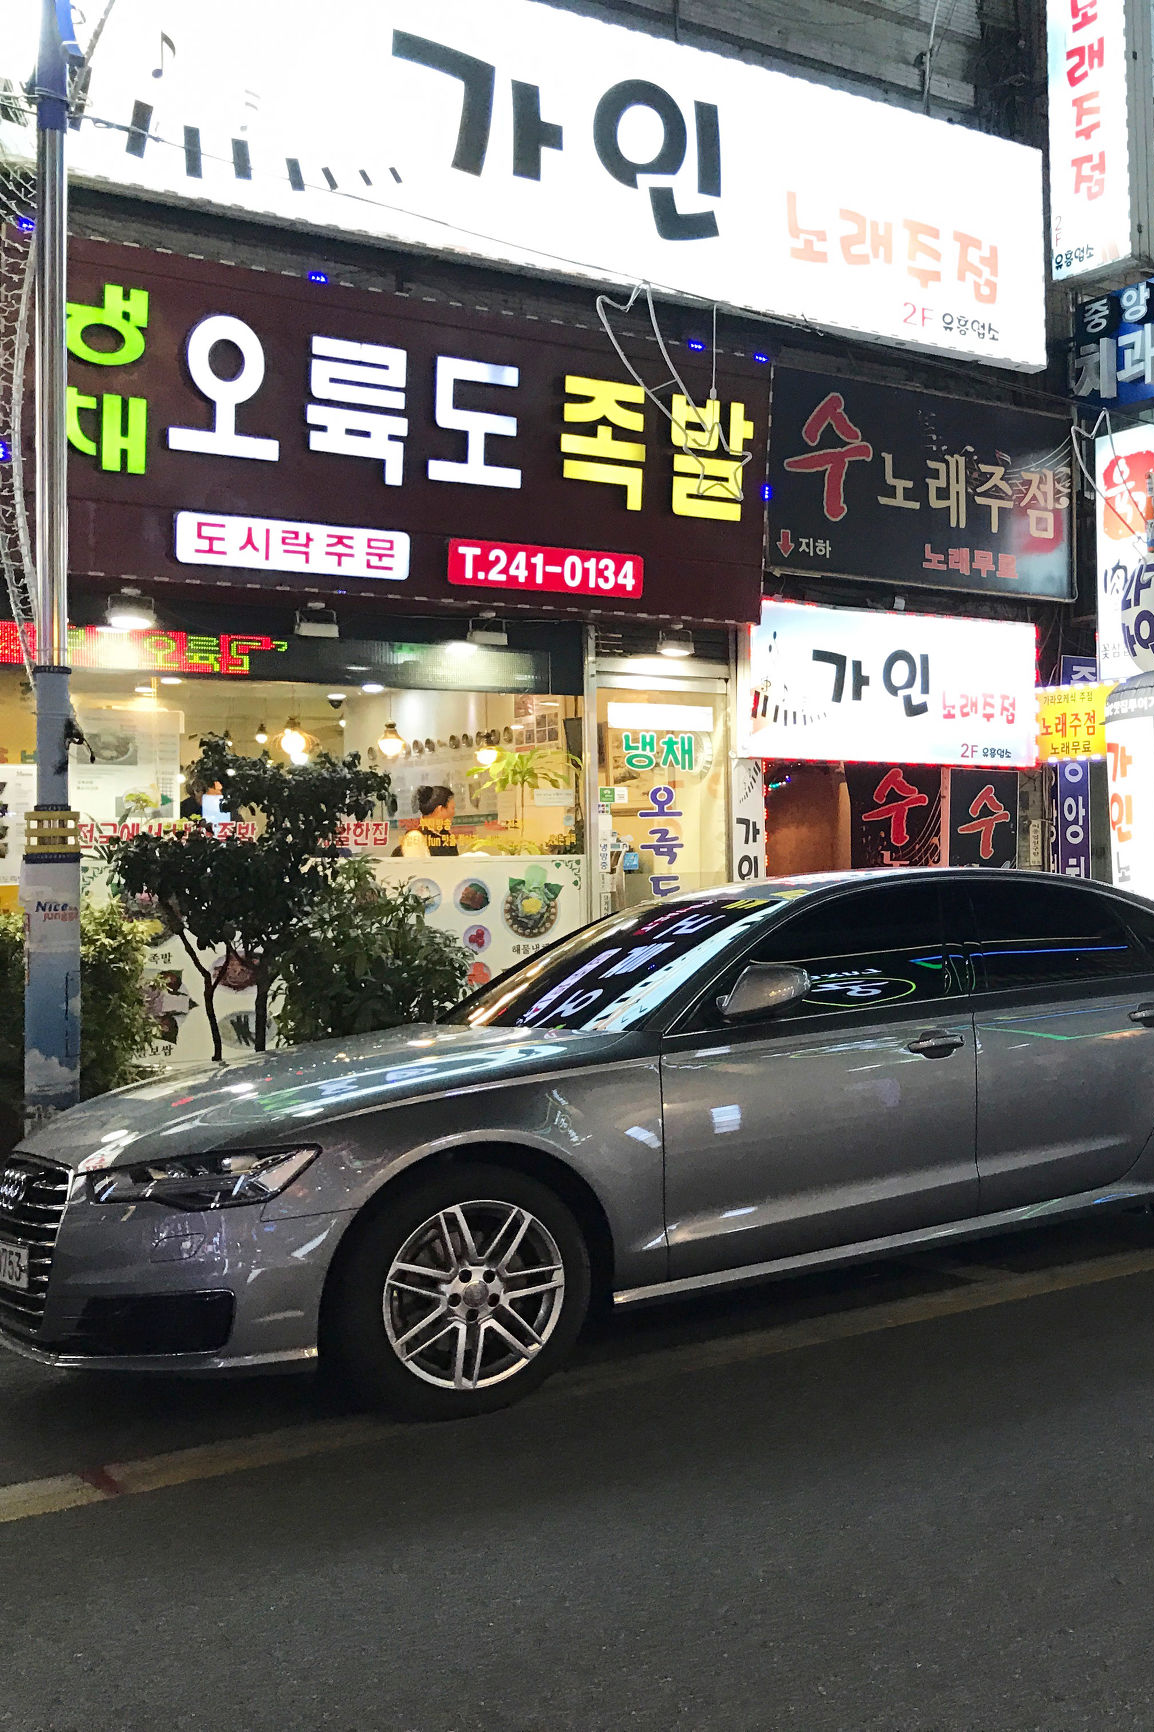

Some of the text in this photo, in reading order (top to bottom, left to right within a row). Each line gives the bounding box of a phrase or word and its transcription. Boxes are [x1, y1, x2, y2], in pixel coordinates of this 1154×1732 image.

[391, 28, 722, 241] 가인
[786, 190, 999, 305] 노래주점
[902, 302, 935, 329] 2F
[166, 313, 755, 522] 오륙도 족발
[783, 391, 1056, 540] 수 노래주점
[193, 520, 395, 572] 도시락주문
[457, 545, 636, 591] T.241-0134
[798, 536, 832, 560] 지하
[811, 649, 1018, 726] 가인 노래주점
[1040, 709, 1097, 739] 노래주점
[1050, 740, 1093, 755] 노래무료
[622, 733, 695, 770] 냉채
[960, 743, 979, 760] 2F
[861, 767, 929, 846] 수
[957, 784, 1011, 860] 수
[35, 900, 69, 914] Nice
